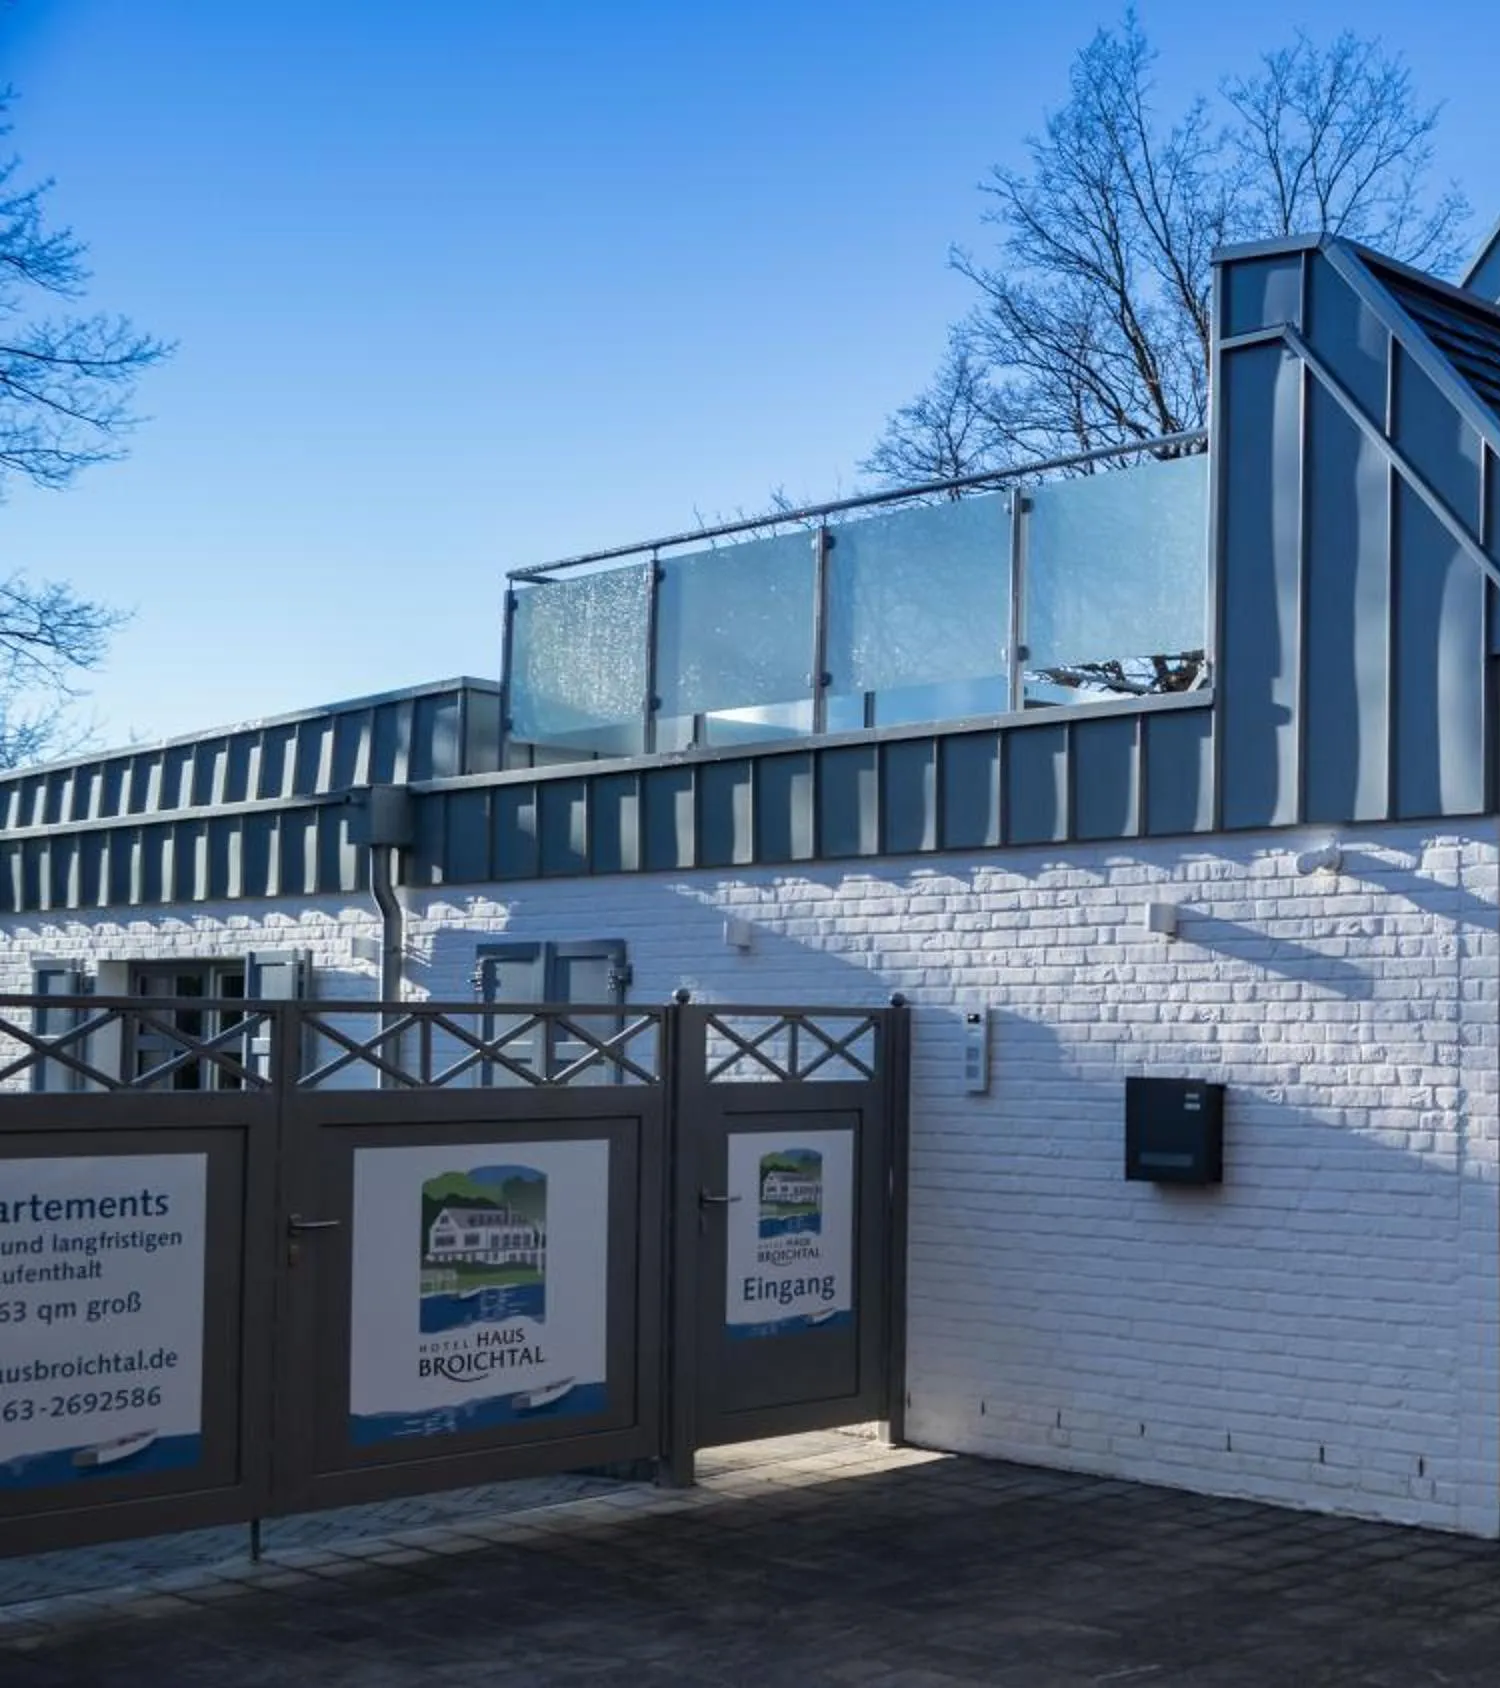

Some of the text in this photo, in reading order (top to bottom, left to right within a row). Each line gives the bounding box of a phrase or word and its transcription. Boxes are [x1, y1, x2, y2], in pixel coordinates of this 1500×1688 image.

[1, 1229, 183, 1258] und langfristigen
[757, 1247, 820, 1267] BROICHTAL
[0, 1260, 103, 1285] ufenthalt
[743, 1275, 835, 1305] Eingang
[37, 1299, 76, 1326] qm
[86, 1291, 142, 1323] groß
[419, 1328, 526, 1353] HOTEL HAUS
[0, 1347, 178, 1384] usbroichtal.de
[418, 1345, 545, 1383] BROICHTAL
